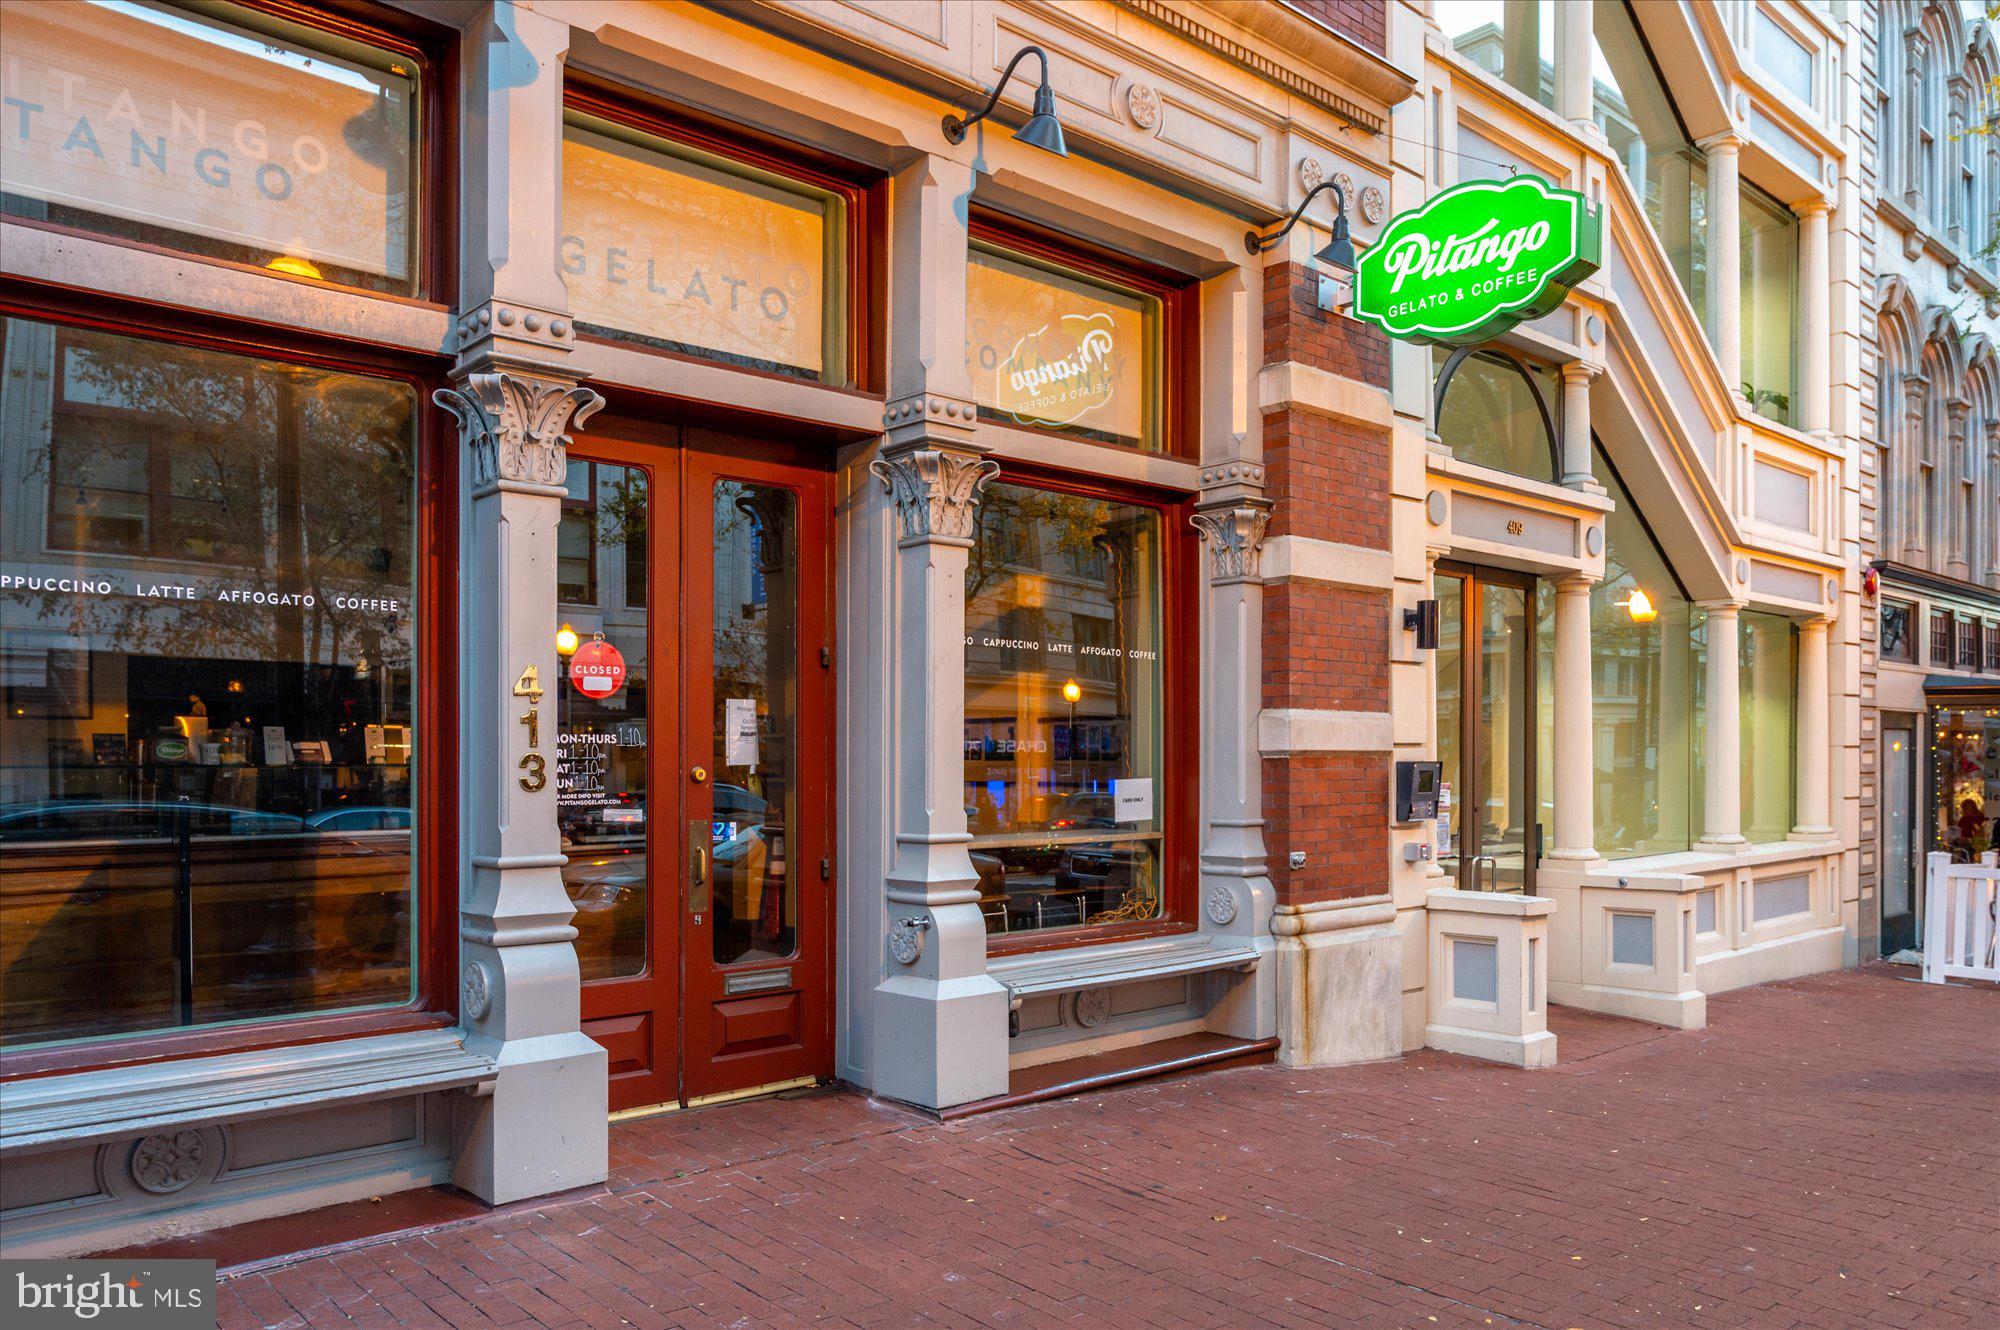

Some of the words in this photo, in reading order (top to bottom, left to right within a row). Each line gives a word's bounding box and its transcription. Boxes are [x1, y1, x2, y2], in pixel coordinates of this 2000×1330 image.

[4, 96, 293, 202] TANGO
[1384, 217, 1550, 295] Pitango
[560, 235, 789, 322] GELATO
[1387, 291, 1449, 318] GELATO
[1455, 289, 1465, 301] &
[1471, 267, 1538, 297] COFFEE
[1506, 520, 1524, 535] 409
[0, 575, 112, 595] PPUCCINO
[136, 584, 196, 599] LATTE
[218, 590, 315, 607] AFFOGATO
[336, 597, 398, 612] COFFEE
[574, 664, 621, 676] CLOSED
[983, 637, 1040, 650] CAPPUCCINO
[1048, 643, 1073, 653] LATTE
[1080, 646, 1122, 657] AFFOGATO
[1129, 650, 1157, 660] COFFEE
